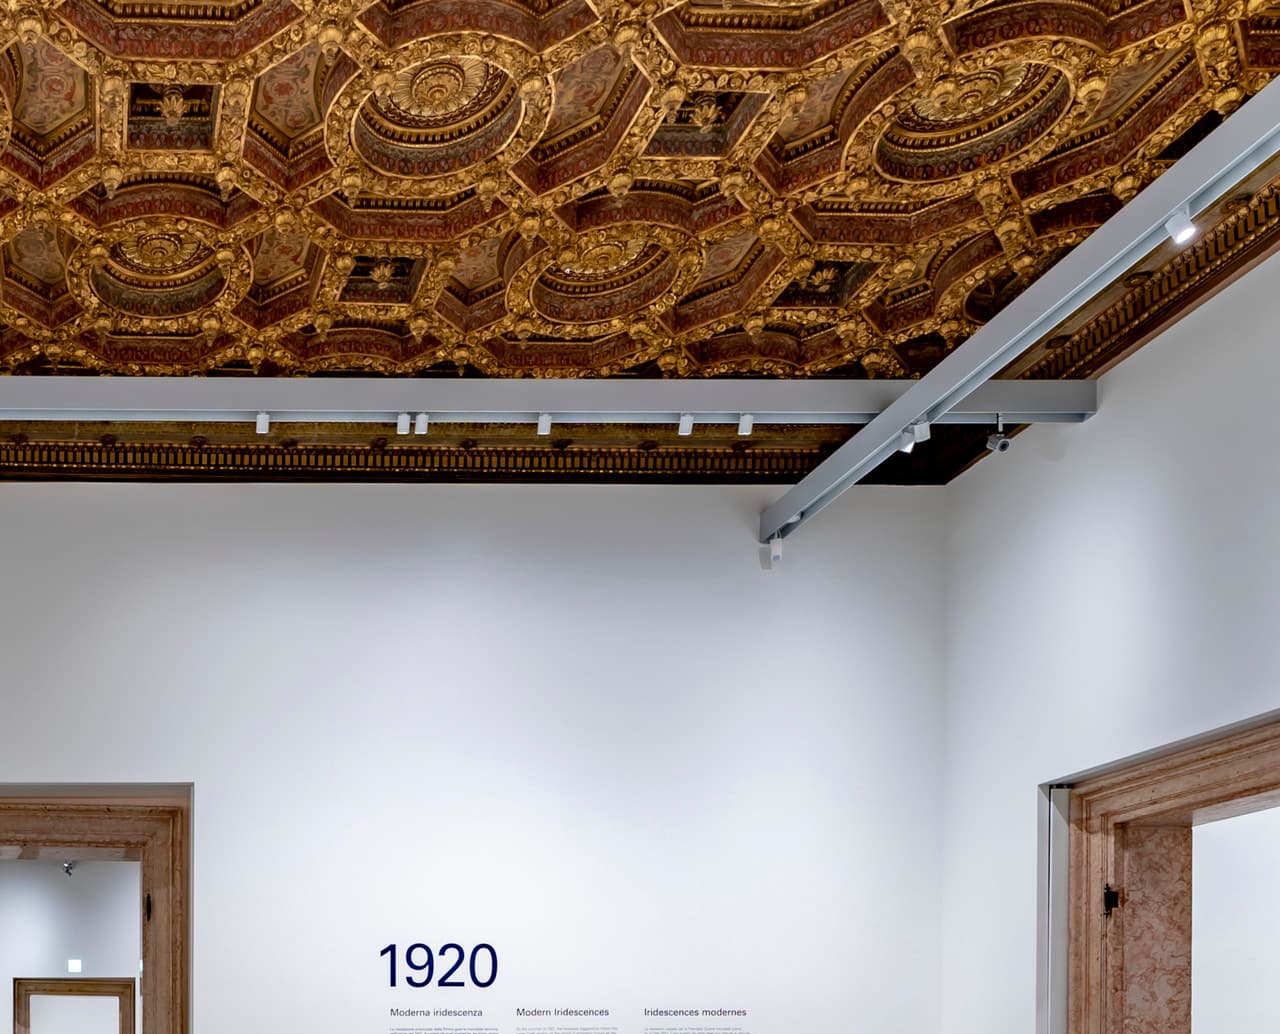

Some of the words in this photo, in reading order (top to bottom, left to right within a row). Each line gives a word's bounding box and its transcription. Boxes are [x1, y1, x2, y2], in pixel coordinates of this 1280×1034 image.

[379, 943, 498, 988] 1920
[389, 1007, 431, 1017] Moderna
[433, 1007, 483, 1017] iridescenza
[516, 1007, 551, 1017] Modern
[553, 1007, 610, 1017] Iridescences
[644, 1007, 700, 1017] Iridescences
[702, 1007, 748, 1017] modernes
